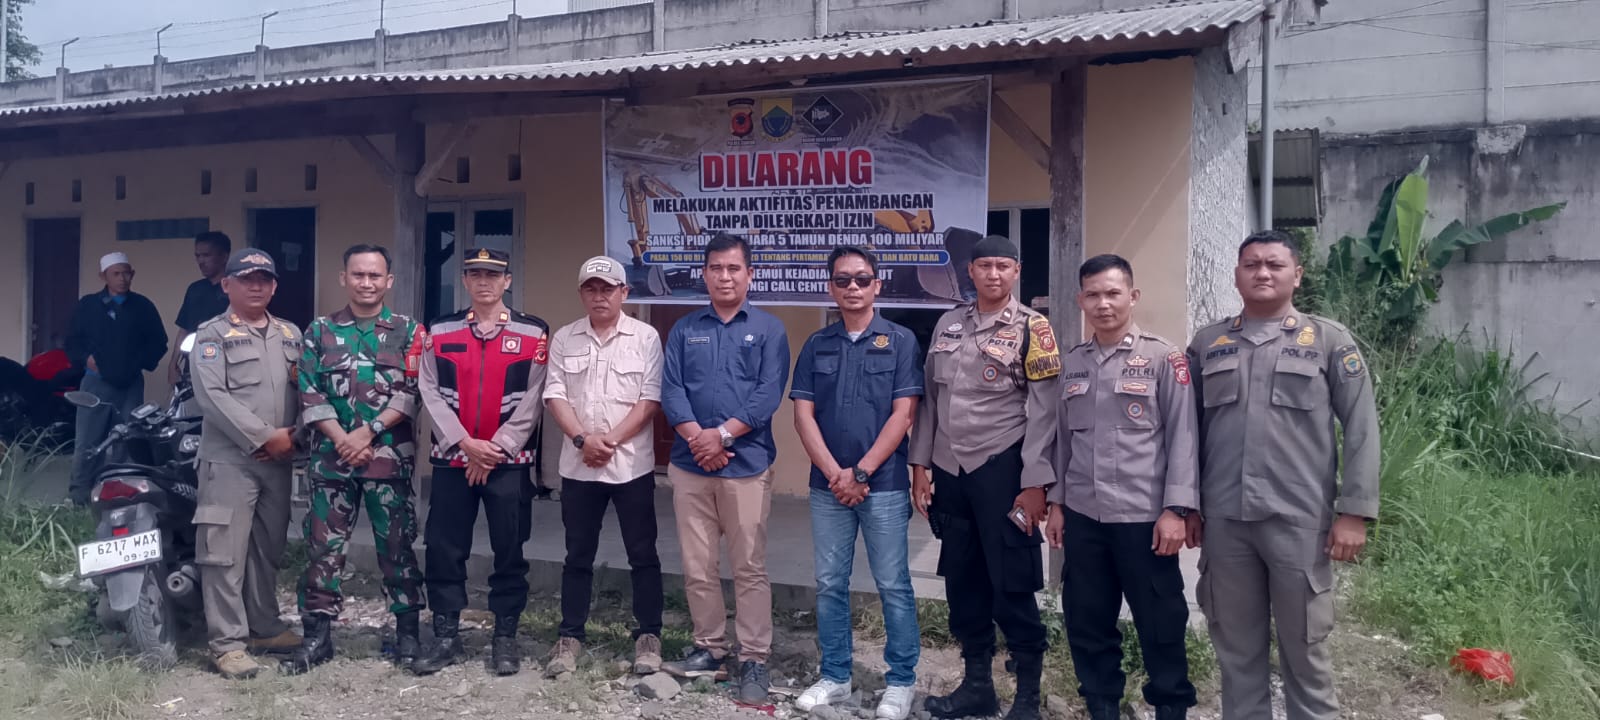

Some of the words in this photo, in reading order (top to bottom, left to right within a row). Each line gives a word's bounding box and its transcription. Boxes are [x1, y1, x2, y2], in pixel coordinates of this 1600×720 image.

[702, 149, 873, 189] DILARANG
[652, 197, 736, 213] MELAKUKAN
[739, 195, 813, 212] AKTIFITAS
[815, 193, 934, 210] PENAMBANGAN
[705, 214, 750, 229] TANPA
[753, 213, 839, 229] DILENGKAPI
[843, 212, 873, 228] IZIN
[646, 235, 684, 246] SANKSI
[686, 235, 713, 246] PIDA
[778, 234, 786, 246] 5
[789, 234, 825, 246] TAHUN
[828, 233, 867, 245] DENDA
[870, 233, 892, 245] 100
[895, 233, 944, 245] MILIYAR
[650, 253, 670, 262] PASAL
[761, 253, 791, 262] TENTANG
[882, 253, 897, 262] DAN
[898, 253, 917, 262] BATU
[919, 253, 939, 262] BARA
[770, 281, 795, 292] CALL
[798, 281, 829, 292] CENTE
[988, 338, 1018, 350] POLRI
[1281, 347, 1300, 358] POL
[1304, 350, 1318, 360] PP
[1121, 367, 1155, 377] POLRI
[81, 547, 88, 560] F
[97, 540, 127, 555] 6217
[133, 533, 157, 547] WAX
